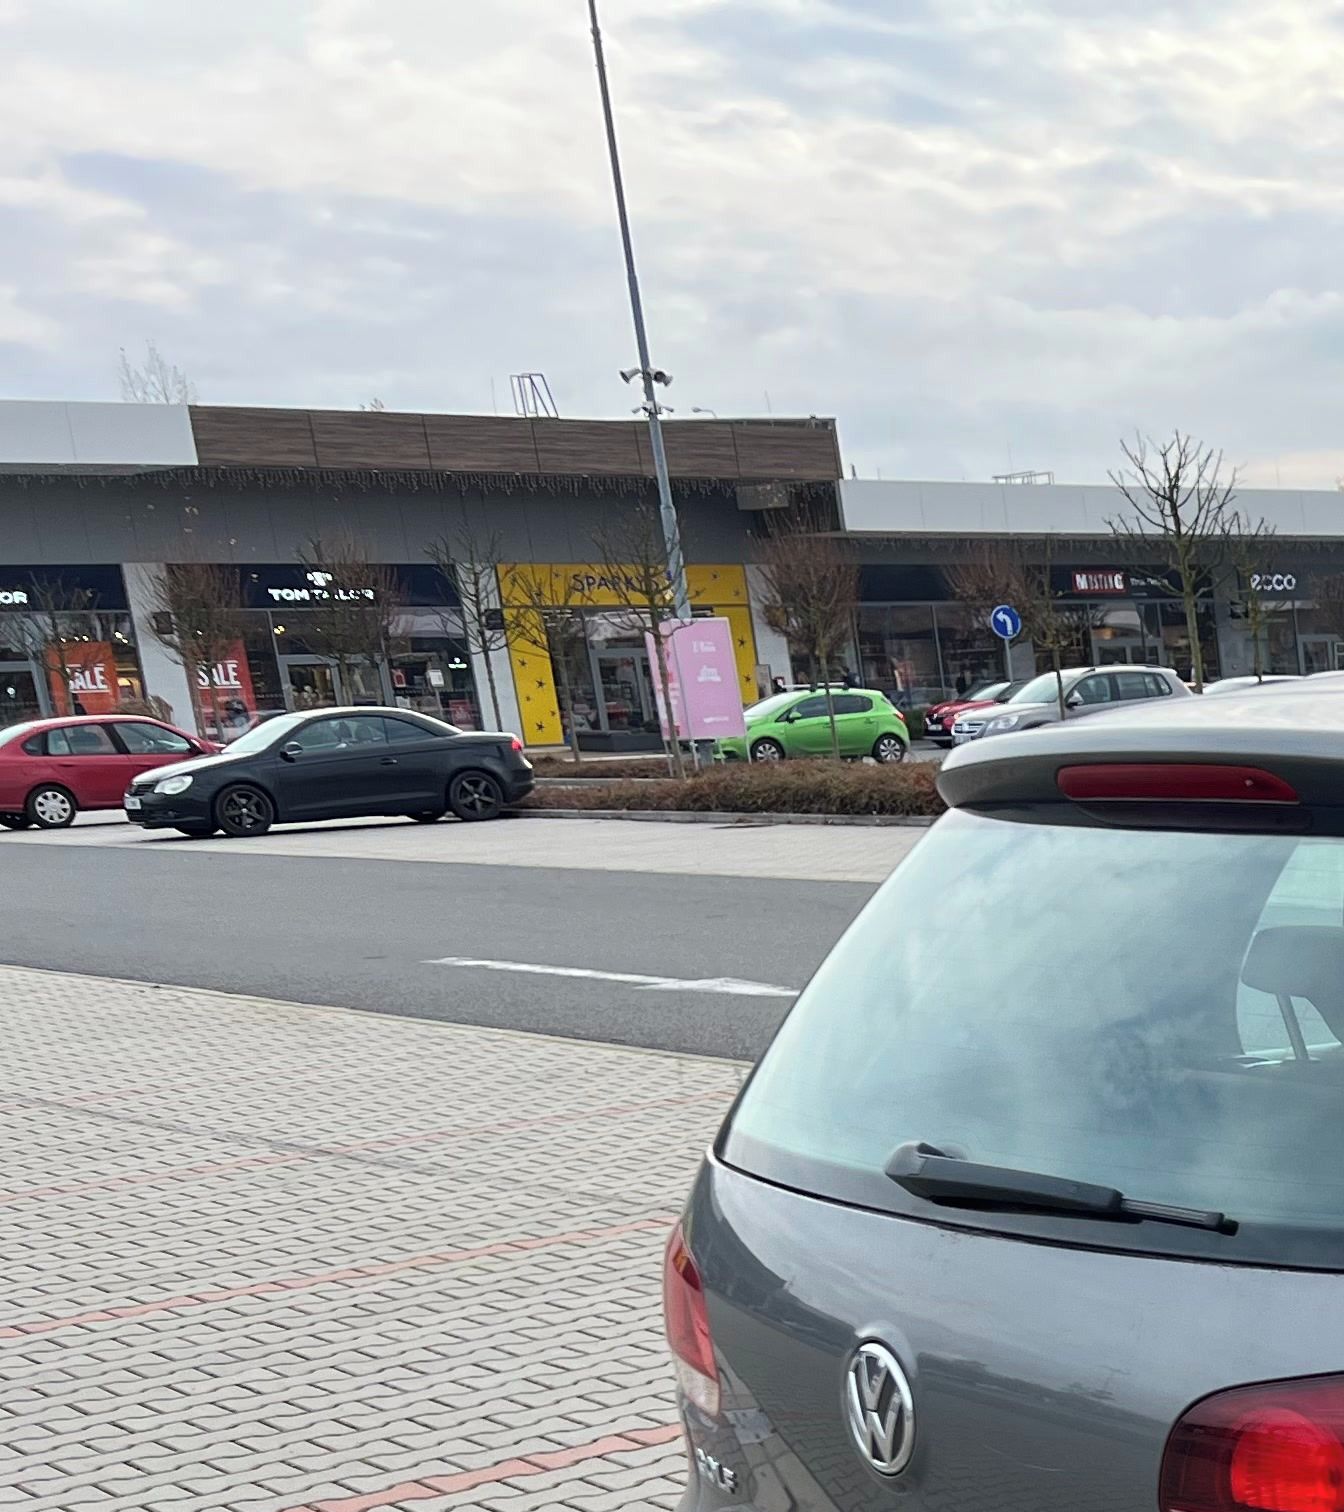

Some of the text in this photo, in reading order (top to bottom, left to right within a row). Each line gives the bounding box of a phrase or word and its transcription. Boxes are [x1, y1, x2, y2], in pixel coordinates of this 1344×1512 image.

[571, 573, 661, 593] SPARK
[267, 588, 375, 601] TOM TALOR
